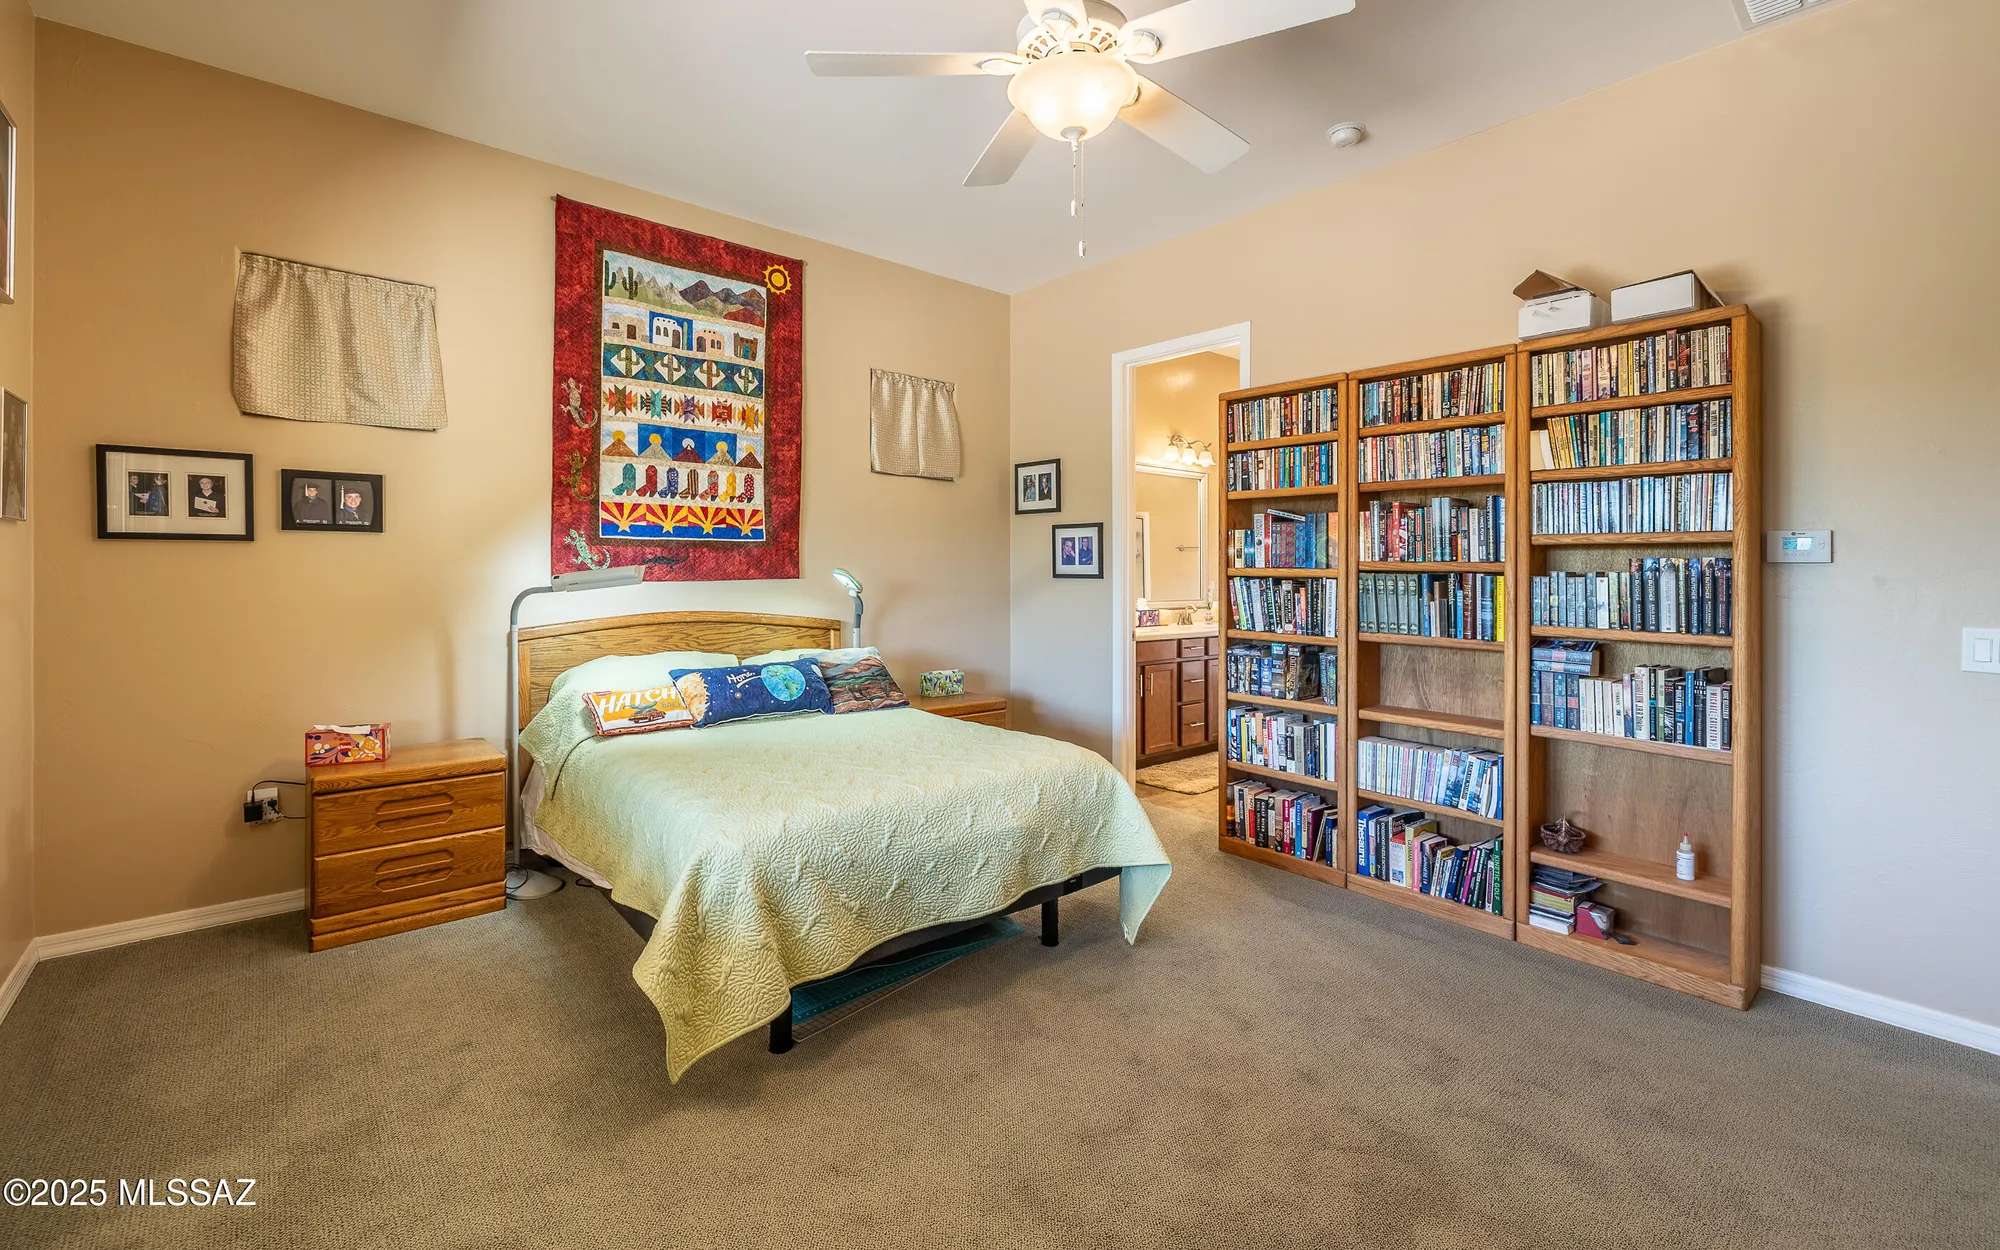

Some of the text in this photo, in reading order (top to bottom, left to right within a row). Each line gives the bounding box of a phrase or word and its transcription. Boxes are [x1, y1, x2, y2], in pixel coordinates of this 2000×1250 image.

[599, 687, 676, 714] HATCH
[1710, 692, 1718, 742] MICHAEL CRICHTON
[1358, 818, 1367, 866] Thesaurus
